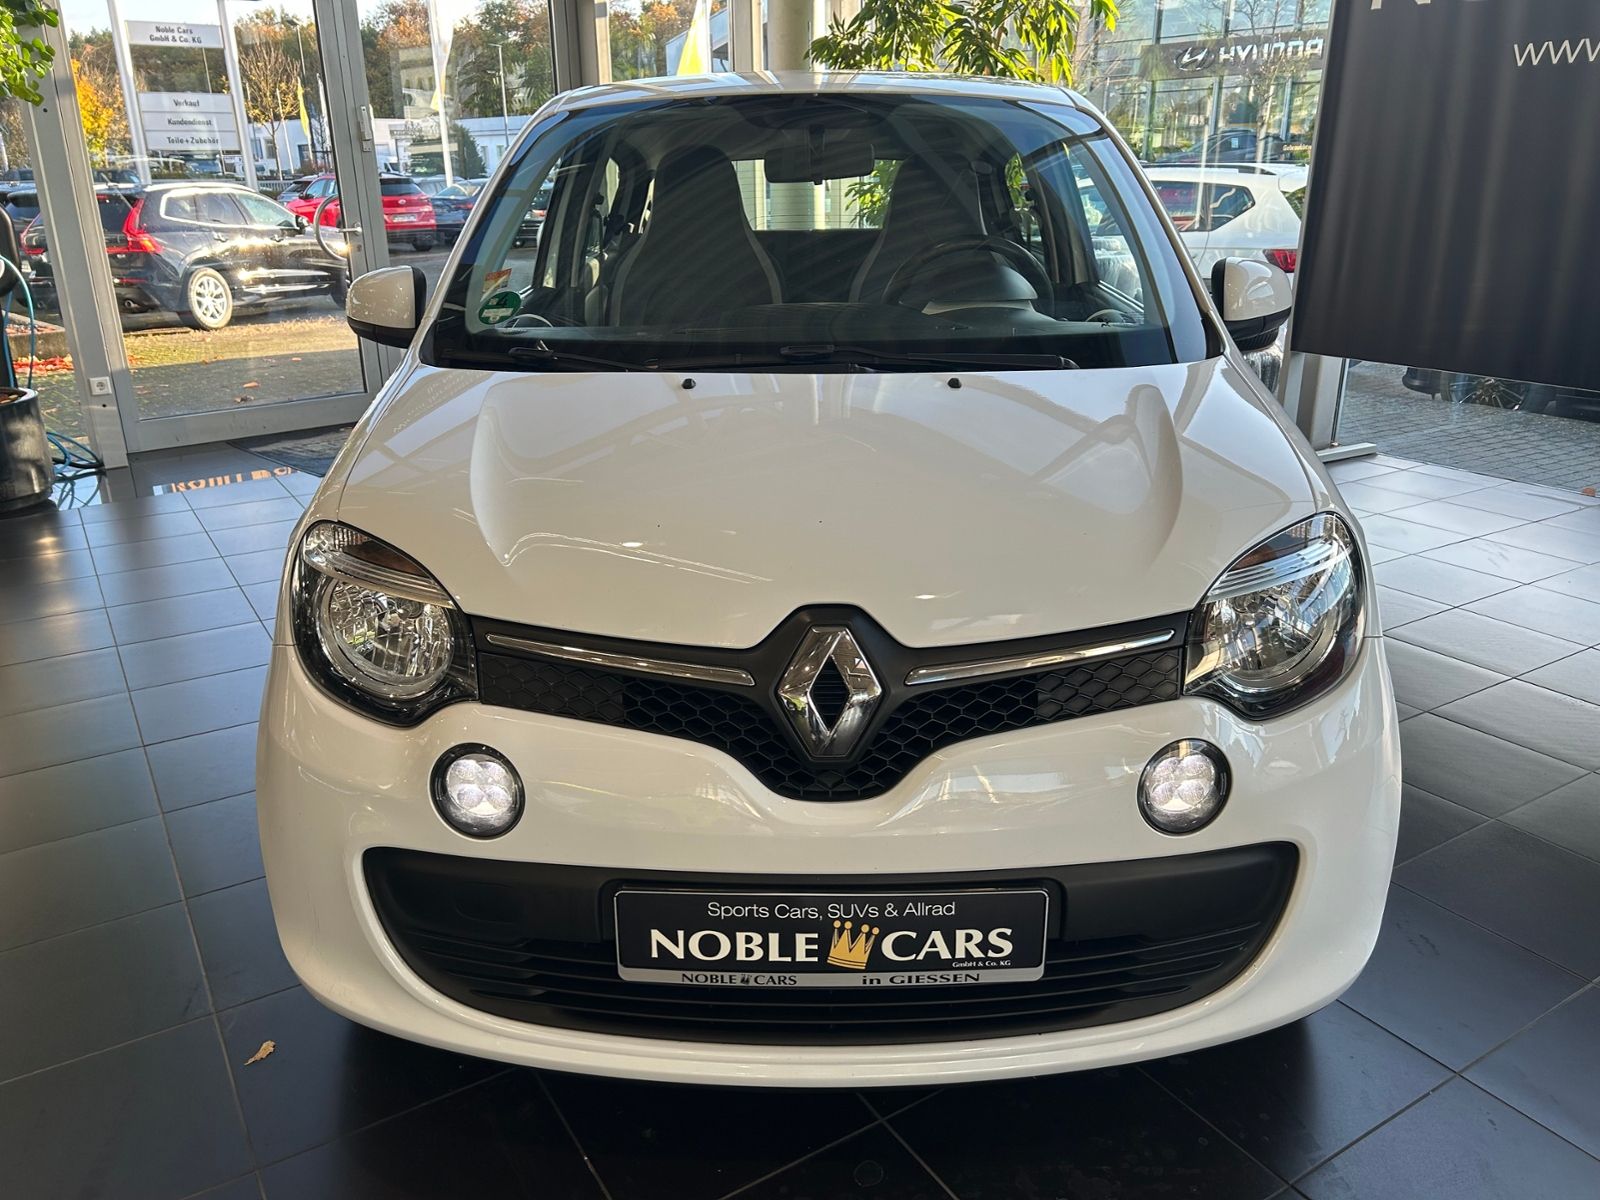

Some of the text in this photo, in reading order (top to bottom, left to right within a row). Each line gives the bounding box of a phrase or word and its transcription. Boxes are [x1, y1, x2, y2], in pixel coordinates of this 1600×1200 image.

[155, 26, 193, 34] Noble Cars
[191, 36, 202, 44] KG
[1218, 38, 1324, 64] HYUNDA
[173, 99, 200, 107] Verkauf
[167, 118, 212, 126] Kundendienst
[707, 901, 956, 921] Sports Cars, SUVs & Allrad
[650, 927, 1014, 962] NOBLE CARS
[952, 960, 977, 968] GmbH
[681, 973, 980, 986] NOBLE CARS in GIESSEN
